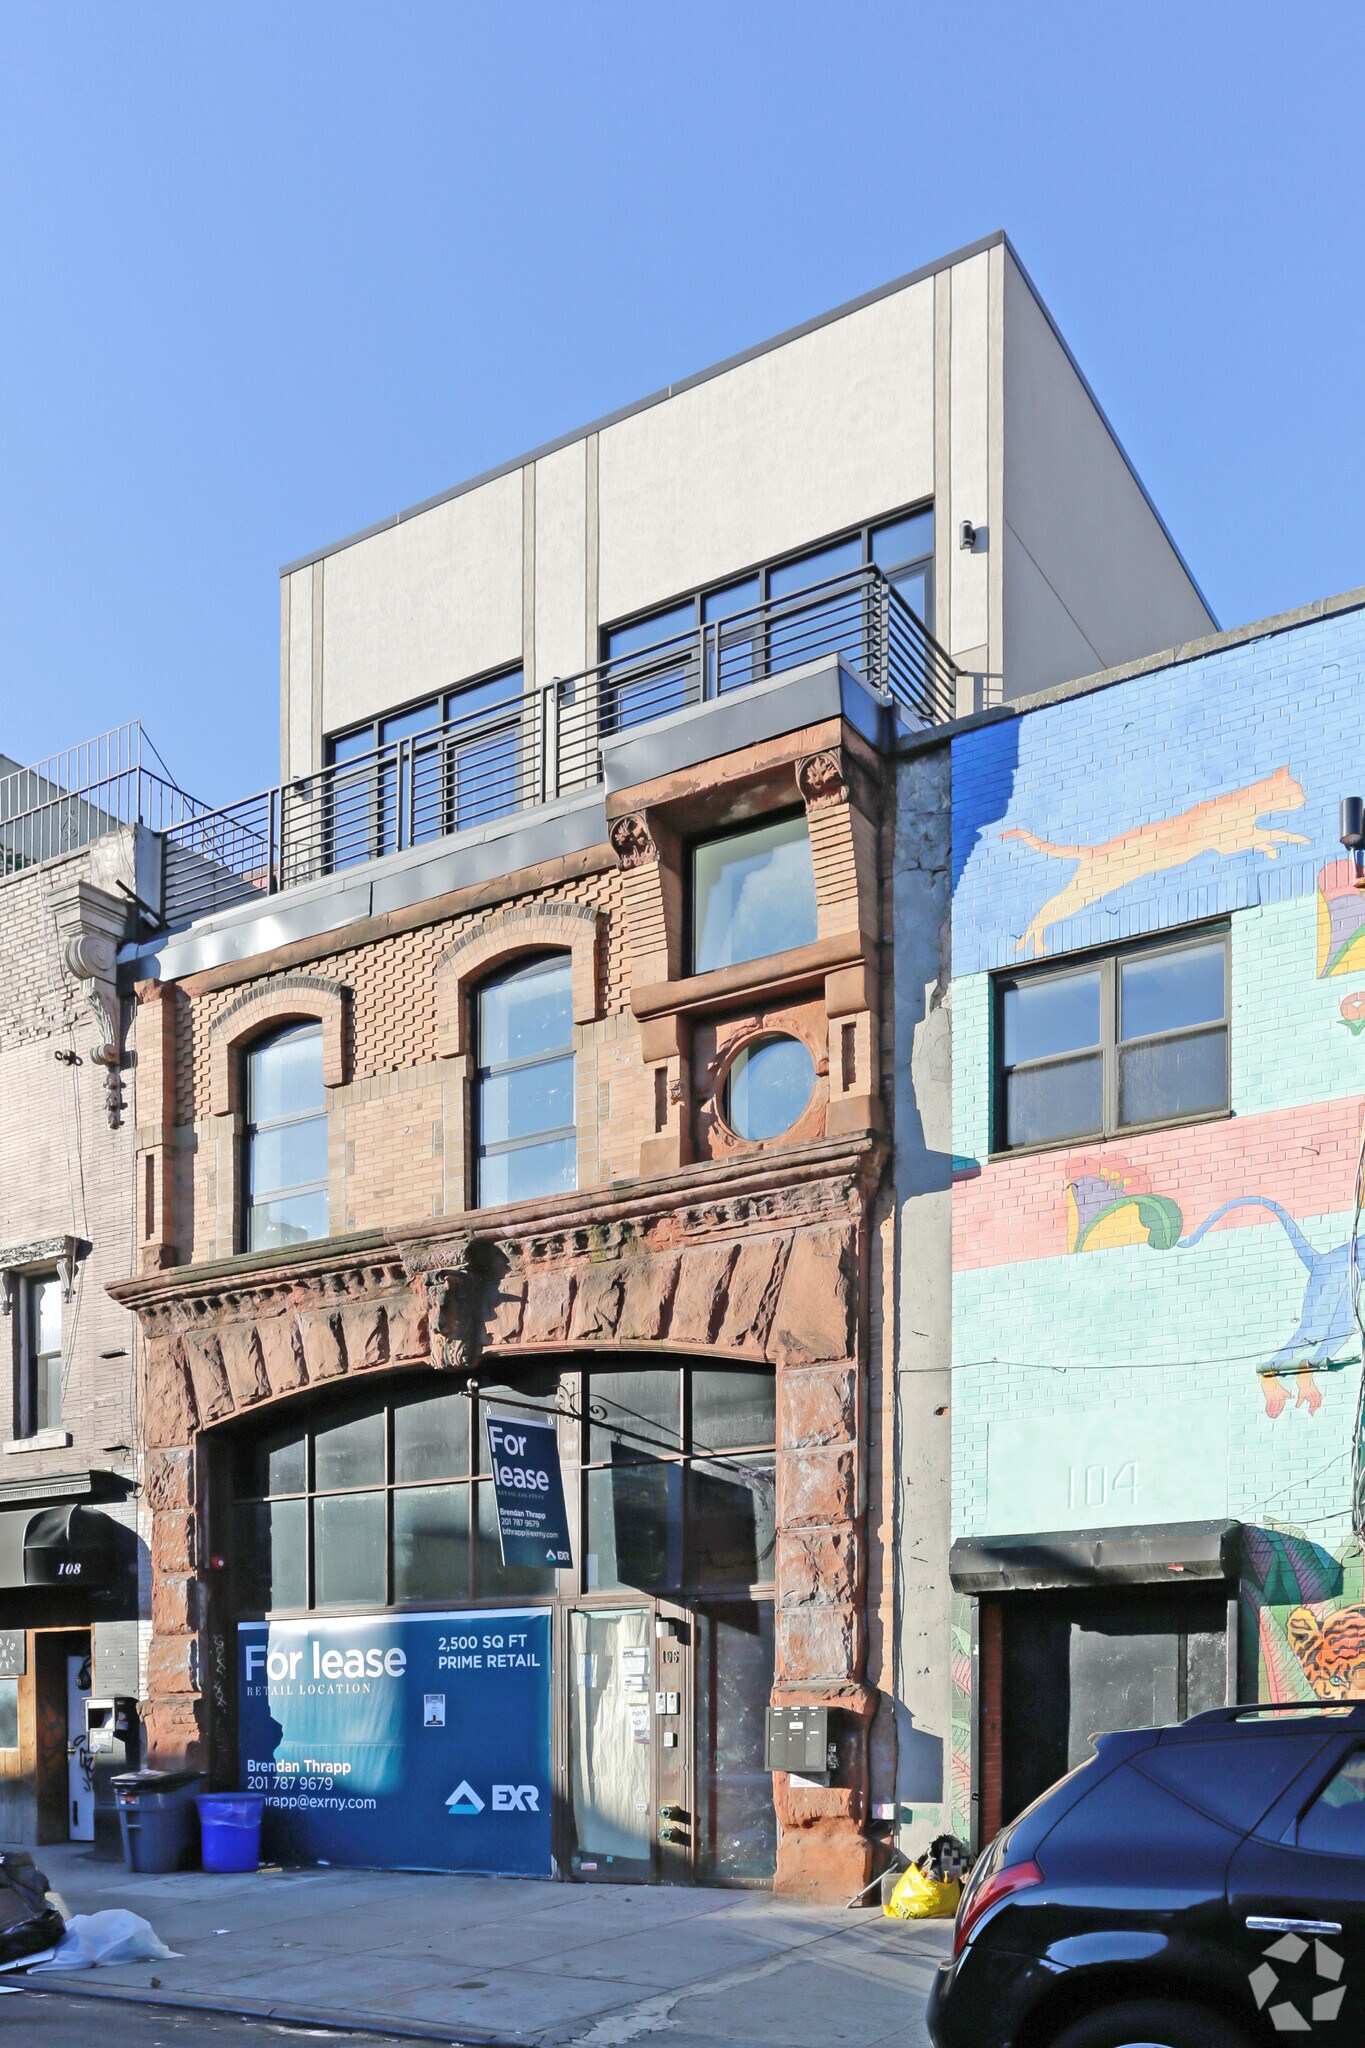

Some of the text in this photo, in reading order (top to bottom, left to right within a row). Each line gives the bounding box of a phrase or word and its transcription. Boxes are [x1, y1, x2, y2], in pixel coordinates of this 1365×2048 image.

[489, 1425, 527, 1457] For
[493, 1458, 550, 1492] lease
[1066, 1460, 1142, 1510] 104
[499, 1507, 546, 1520] Brendan Thrapp
[501, 1518, 540, 1528] 201 787 9679
[557, 1550, 570, 1561] EXR
[58, 1562, 82, 1575] 108
[438, 1633, 527, 1653] 2,500 SQ FT
[245, 1645, 303, 1681] For
[312, 1640, 407, 1680] lease
[438, 1653, 541, 1669] PRIME RETAIL
[661, 1650, 680, 1664] 106
[246, 1682, 372, 1697] RETAIL LOCATION
[247, 1759, 352, 1776] Brendan Thrapp
[247, 1776, 334, 1791] 201 787 9679
[492, 1784, 540, 1812] EXR
